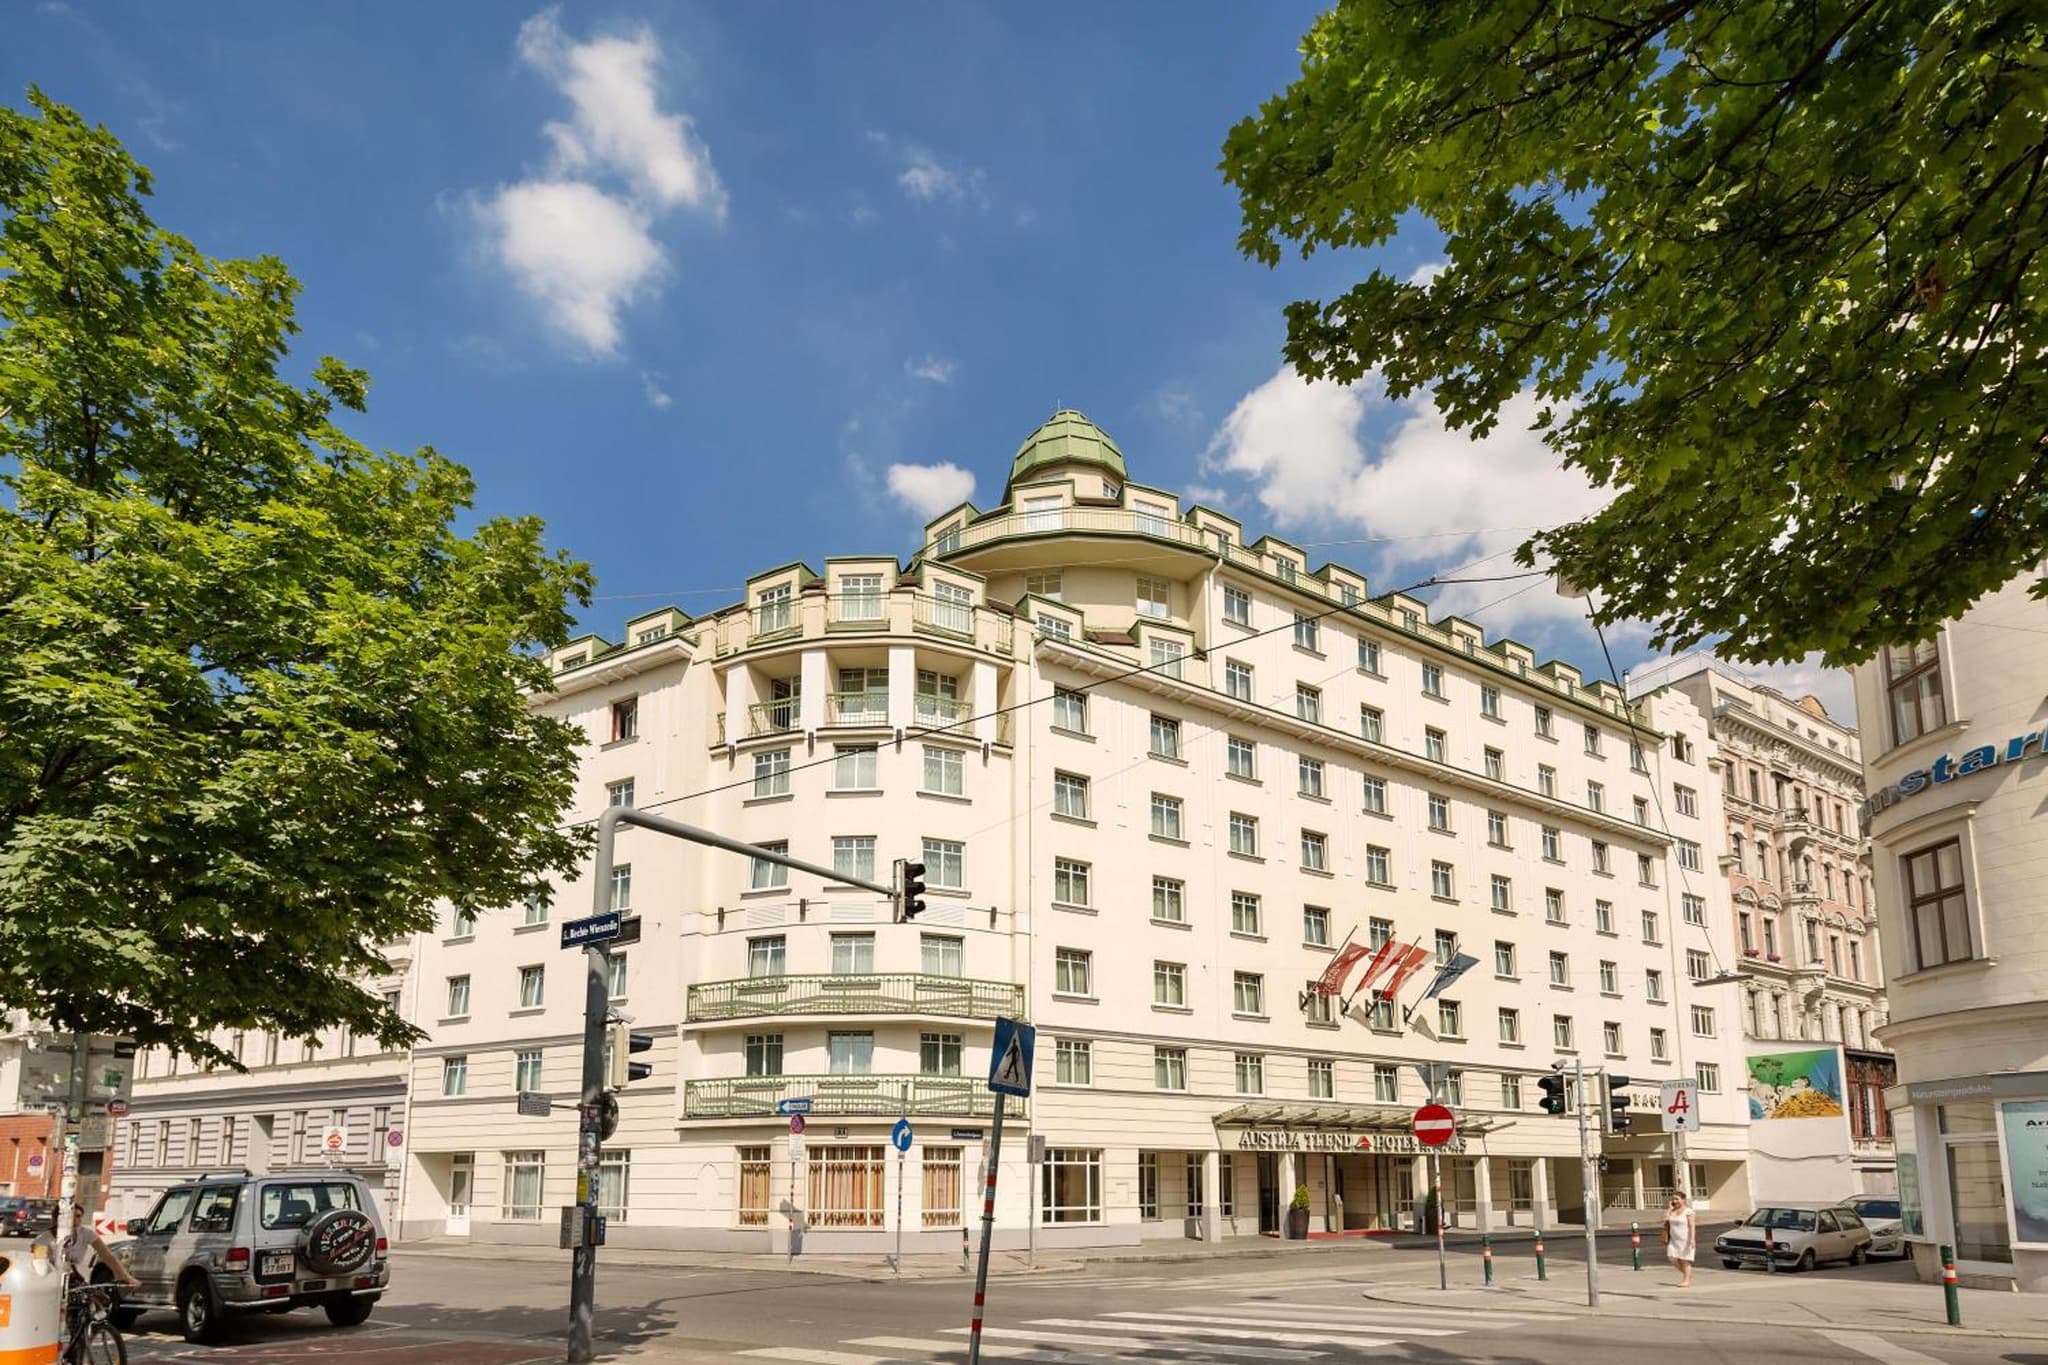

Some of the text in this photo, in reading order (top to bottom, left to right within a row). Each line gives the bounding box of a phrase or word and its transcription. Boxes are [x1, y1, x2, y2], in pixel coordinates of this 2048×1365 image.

[1239, 1130, 1300, 1149] AUSTRIA
[1304, 1132, 1351, 1151] TREND
[1374, 1134, 1415, 1152] HOTEL
